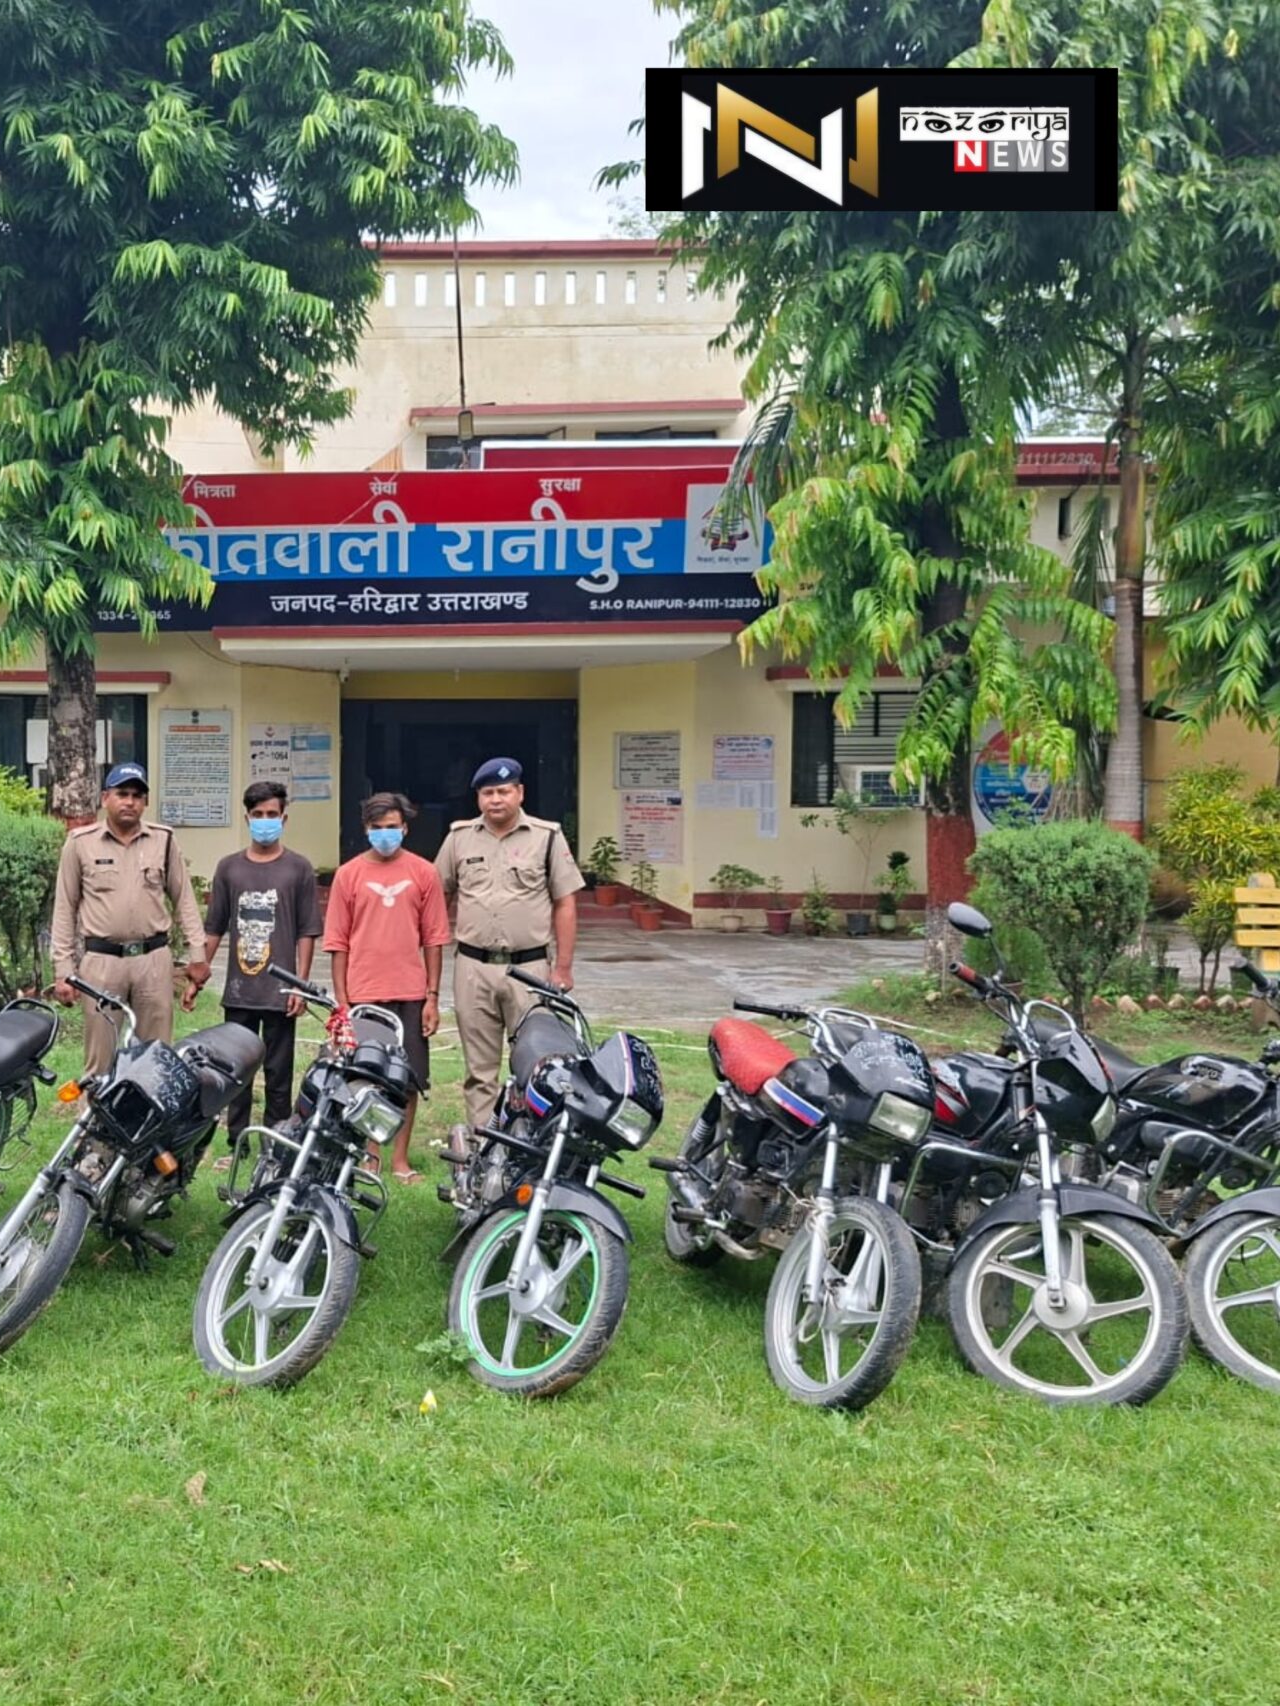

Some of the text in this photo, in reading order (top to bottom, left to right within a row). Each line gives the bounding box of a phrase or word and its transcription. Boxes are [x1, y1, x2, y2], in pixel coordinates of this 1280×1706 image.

[194, 482, 236, 499] मित्रता
[370, 477, 398, 496] सेवा
[539, 477, 582, 496] सुरक्षा
[436, 496, 663, 594] रानीपुर
[427, 591, 529, 612] उत्तराखण्ड
[589, 600, 623, 611] S.H.O
